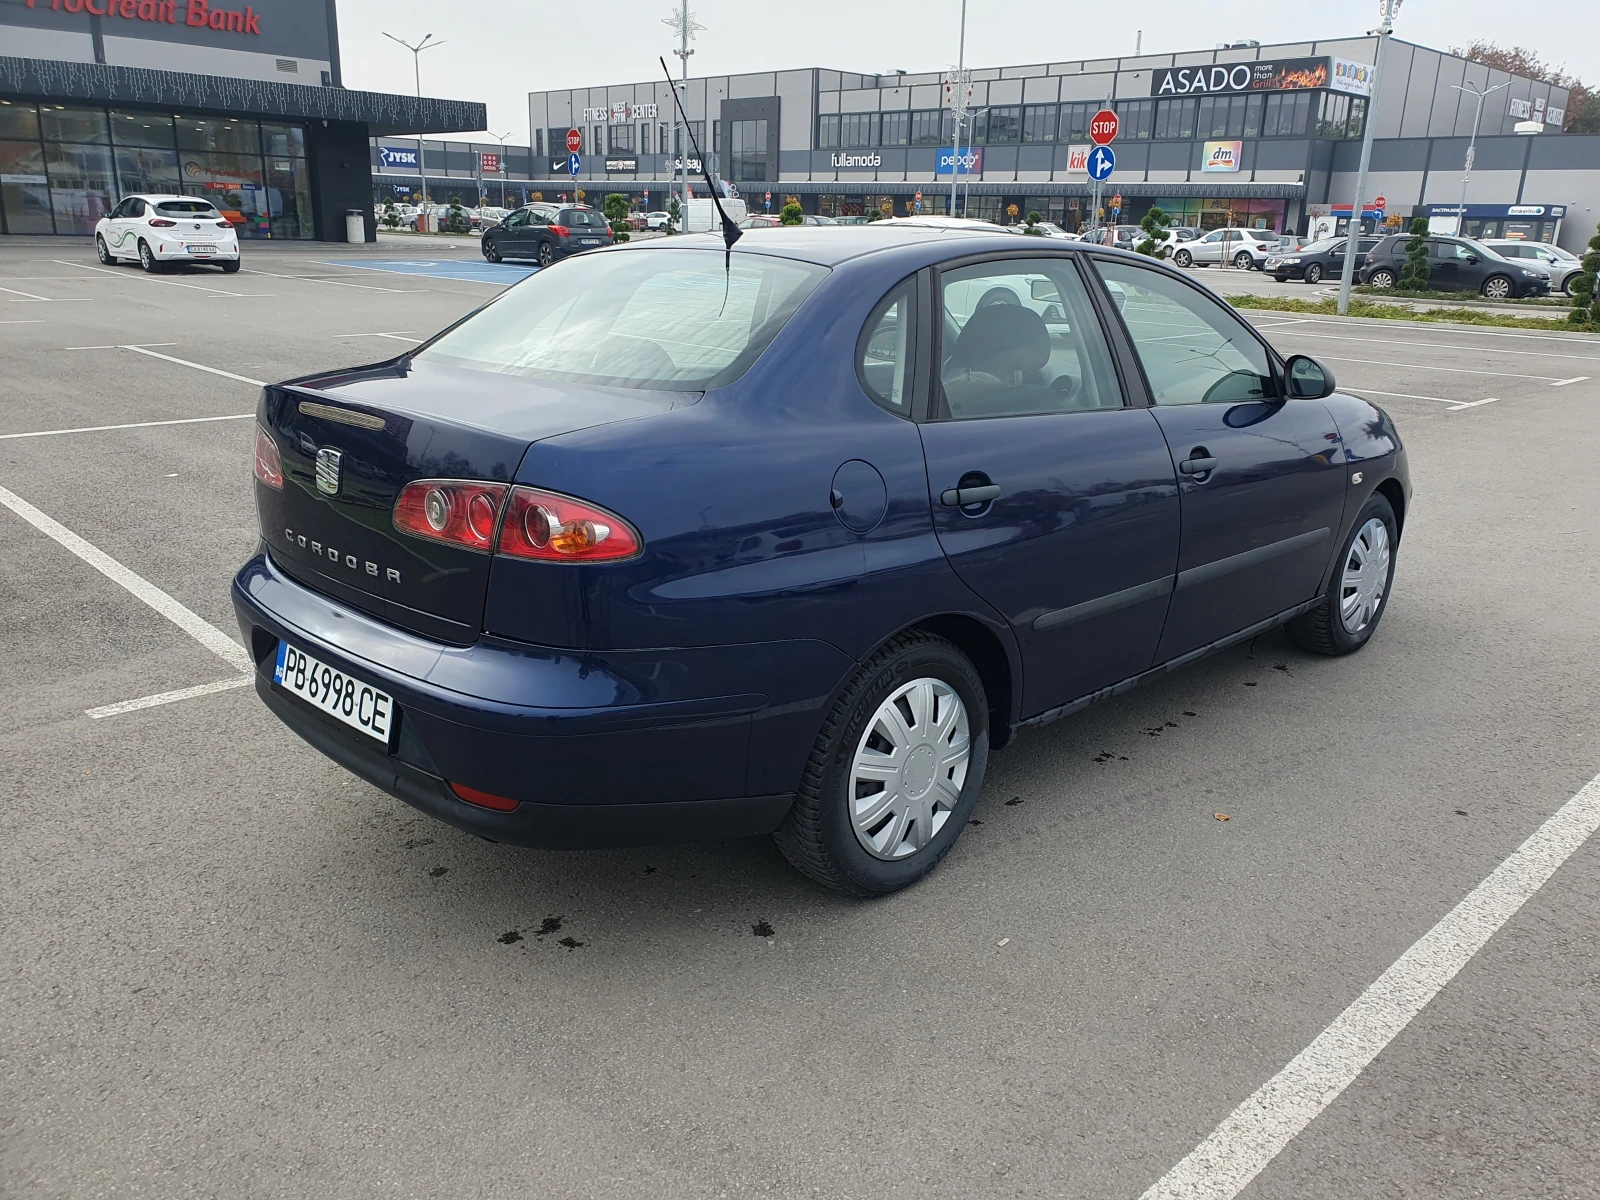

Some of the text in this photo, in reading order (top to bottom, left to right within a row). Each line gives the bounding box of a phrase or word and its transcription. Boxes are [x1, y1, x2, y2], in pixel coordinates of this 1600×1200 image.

[26, 0, 261, 35] oCredit Bank
[1158, 65, 1251, 95] ASADO
[1252, 79, 1272, 88] Grill
[583, 103, 658, 122] FITNESS CENTER
[612, 101, 627, 112] WEST
[613, 112, 627, 123] GYM
[1092, 121, 1116, 134] STOP
[567, 136, 580, 145] STOP
[388, 152, 416, 163] JYSK
[831, 152, 881, 167] fullamoda
[1069, 148, 1087, 168] kik
[1212, 147, 1232, 160] dm
[675, 156, 702, 173] sisay
[285, 528, 401, 583] CORDOBA
[275, 665, 283, 678] BG
